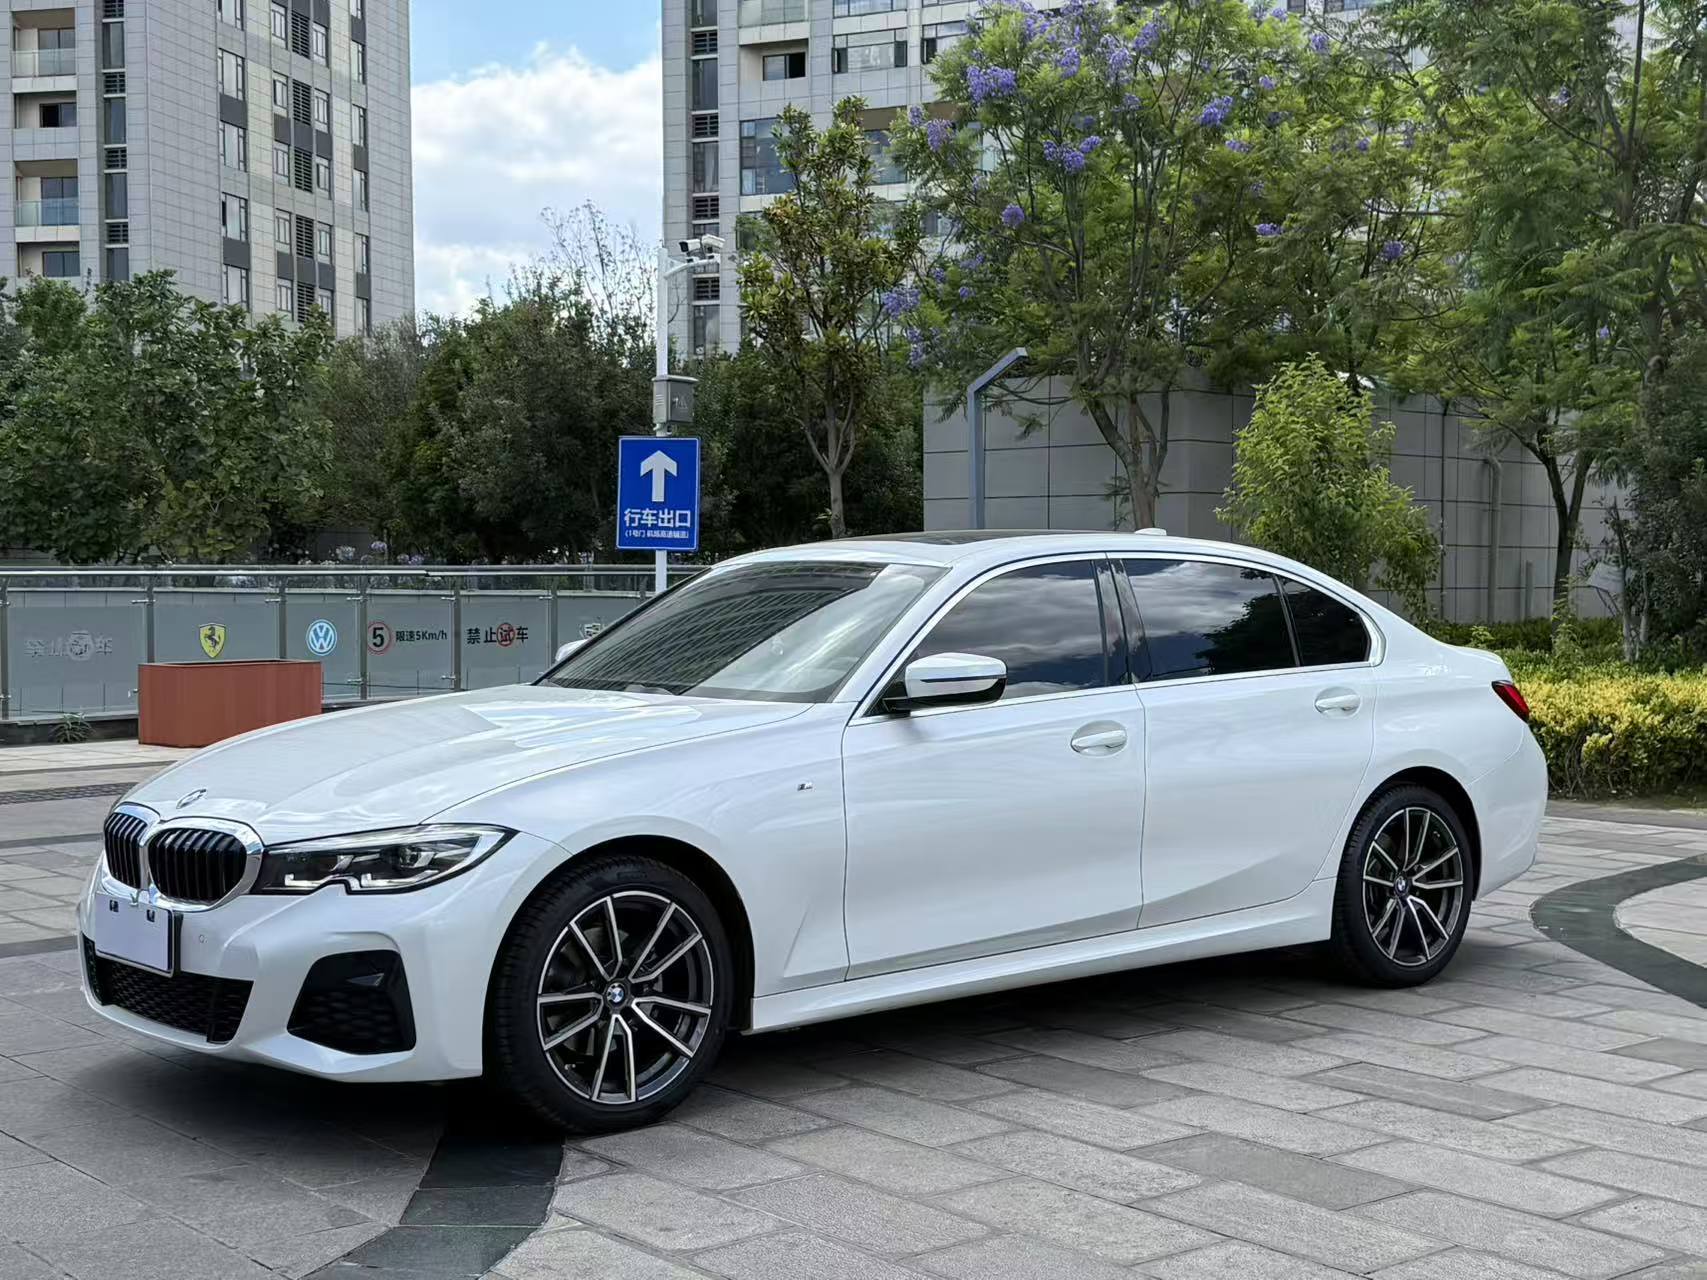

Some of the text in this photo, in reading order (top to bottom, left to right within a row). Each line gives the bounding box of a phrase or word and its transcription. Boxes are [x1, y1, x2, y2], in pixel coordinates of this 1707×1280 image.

[624, 508, 691, 528] 行车出口
[372, 626, 448, 648] 5 限速5Km/h
[466, 626, 529, 645] 禁止试车
